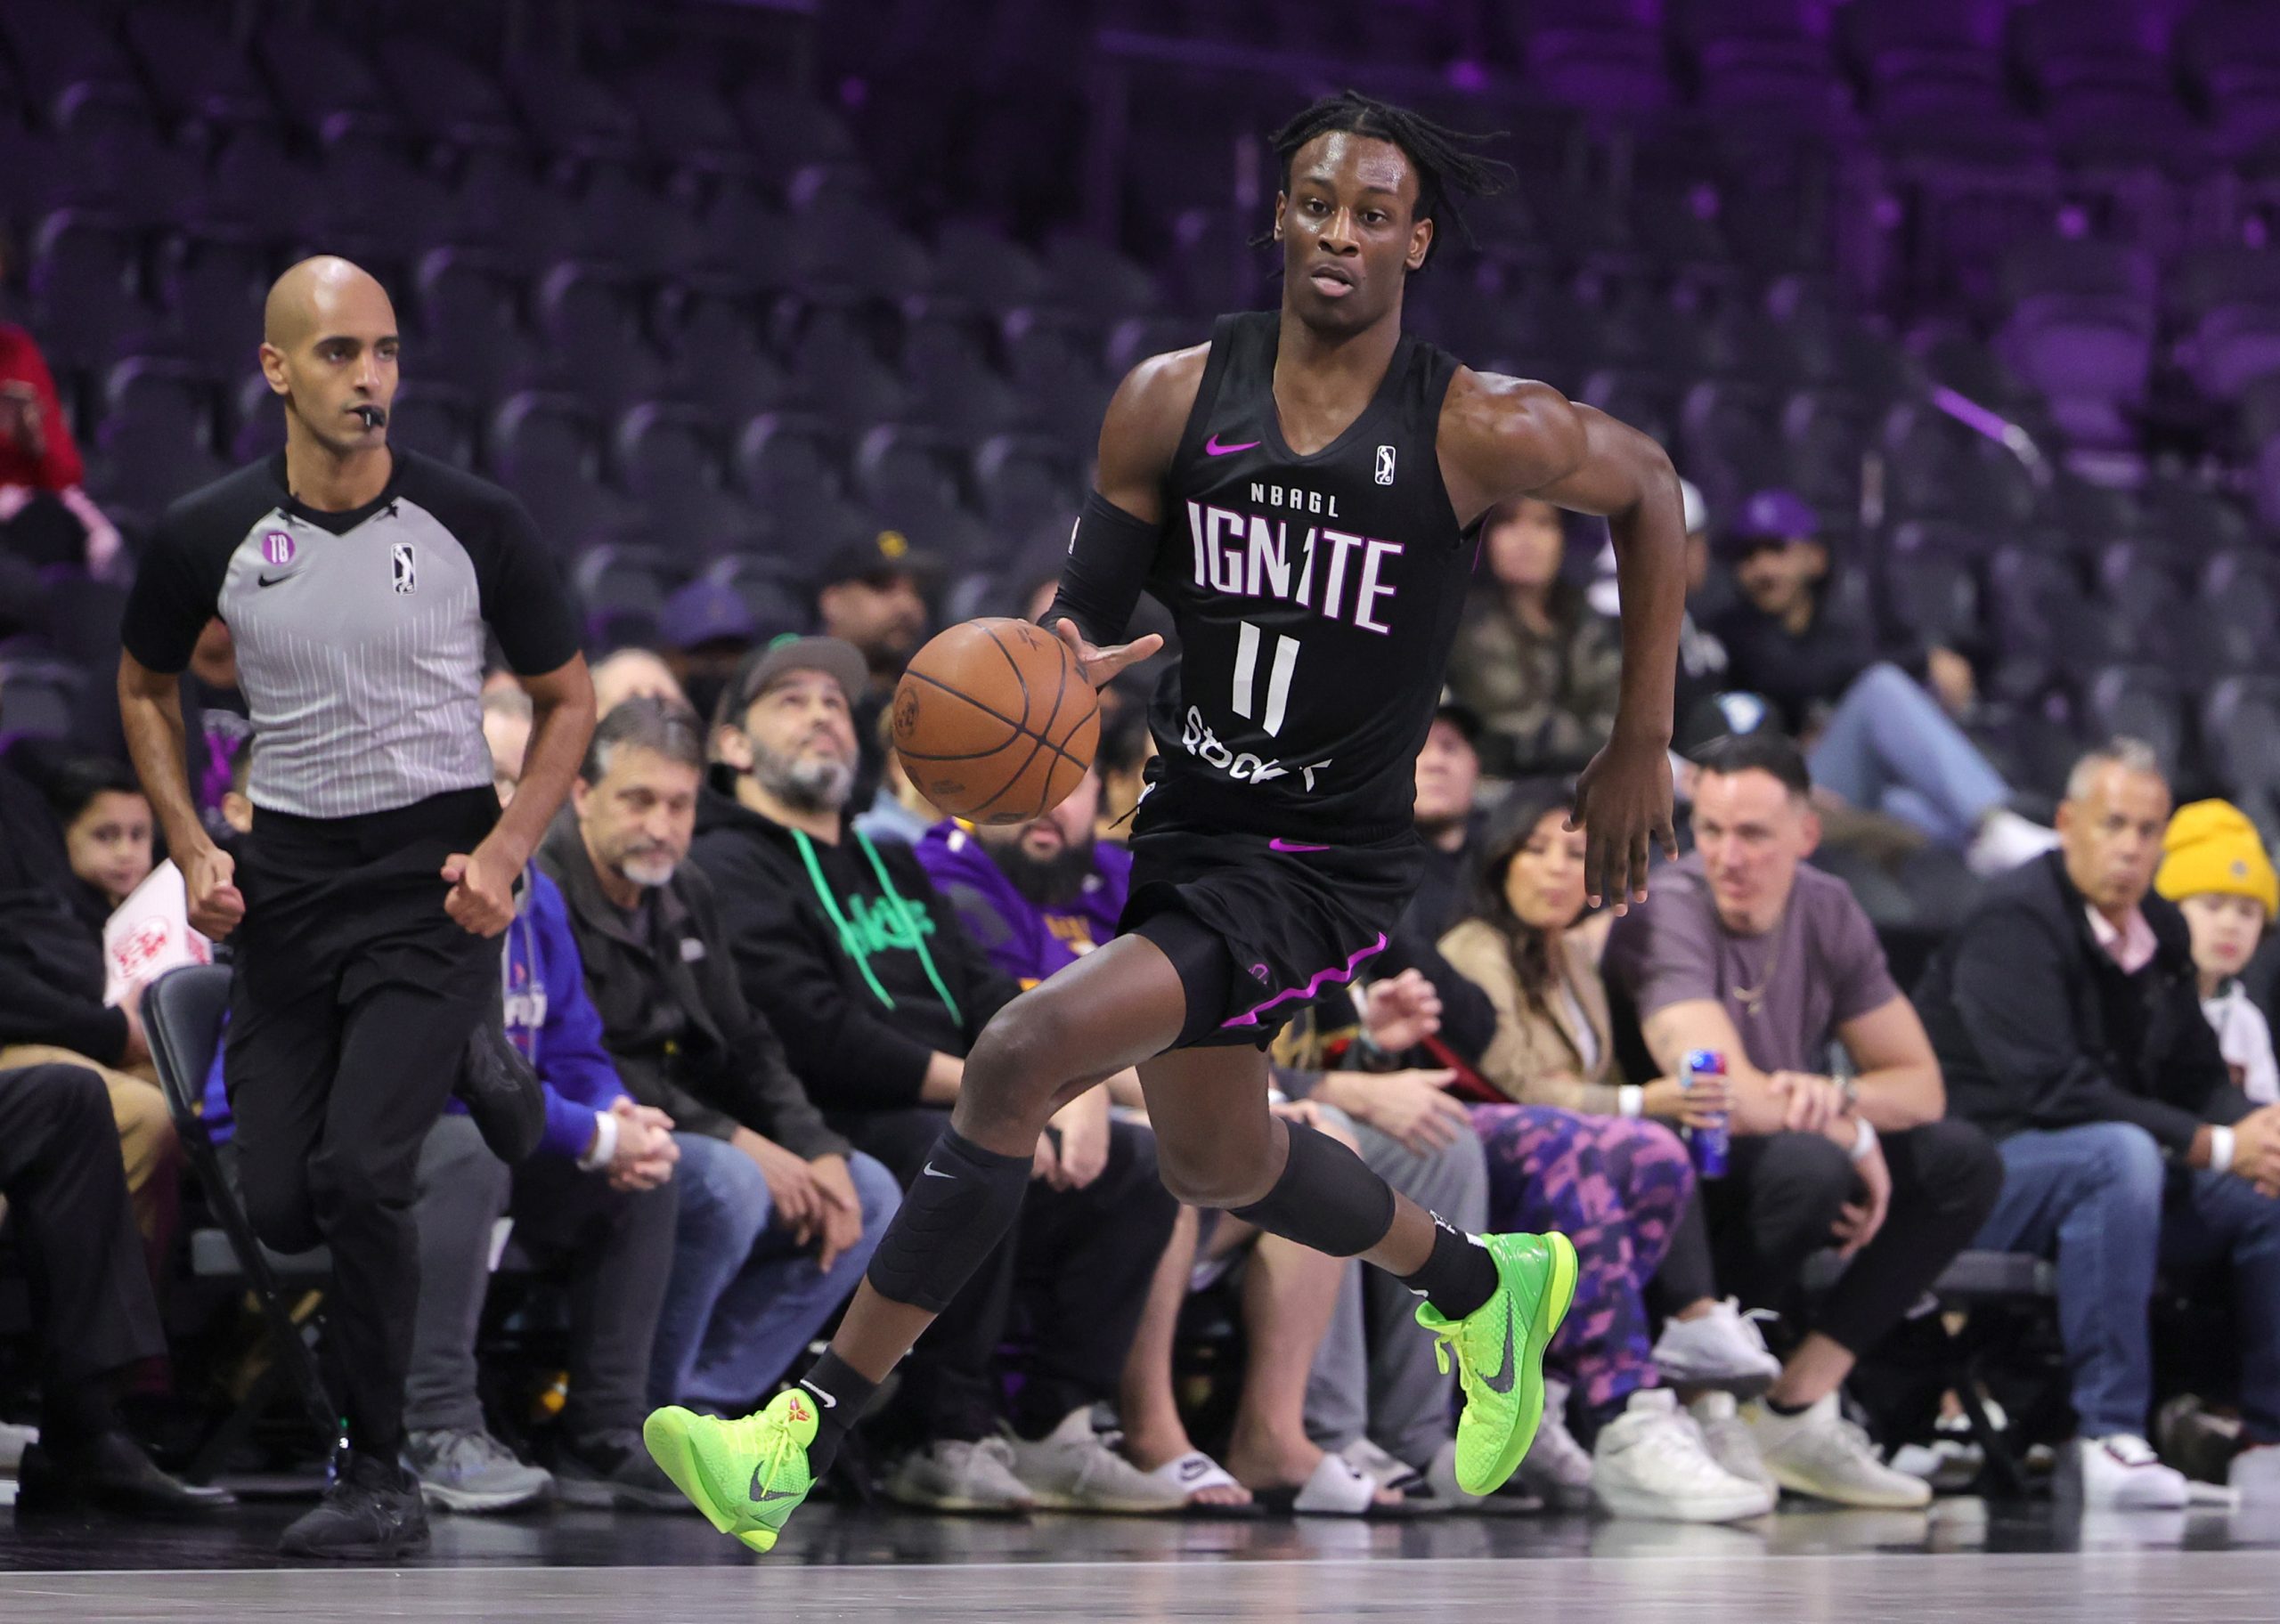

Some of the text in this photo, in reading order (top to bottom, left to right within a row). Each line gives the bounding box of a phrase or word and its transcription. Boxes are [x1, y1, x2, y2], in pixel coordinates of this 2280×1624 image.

[1250, 482, 1339, 517] NBAGL
[268, 534, 289, 563] TB
[1186, 499, 1405, 636] IGNITE
[1232, 620, 1301, 738] 11
